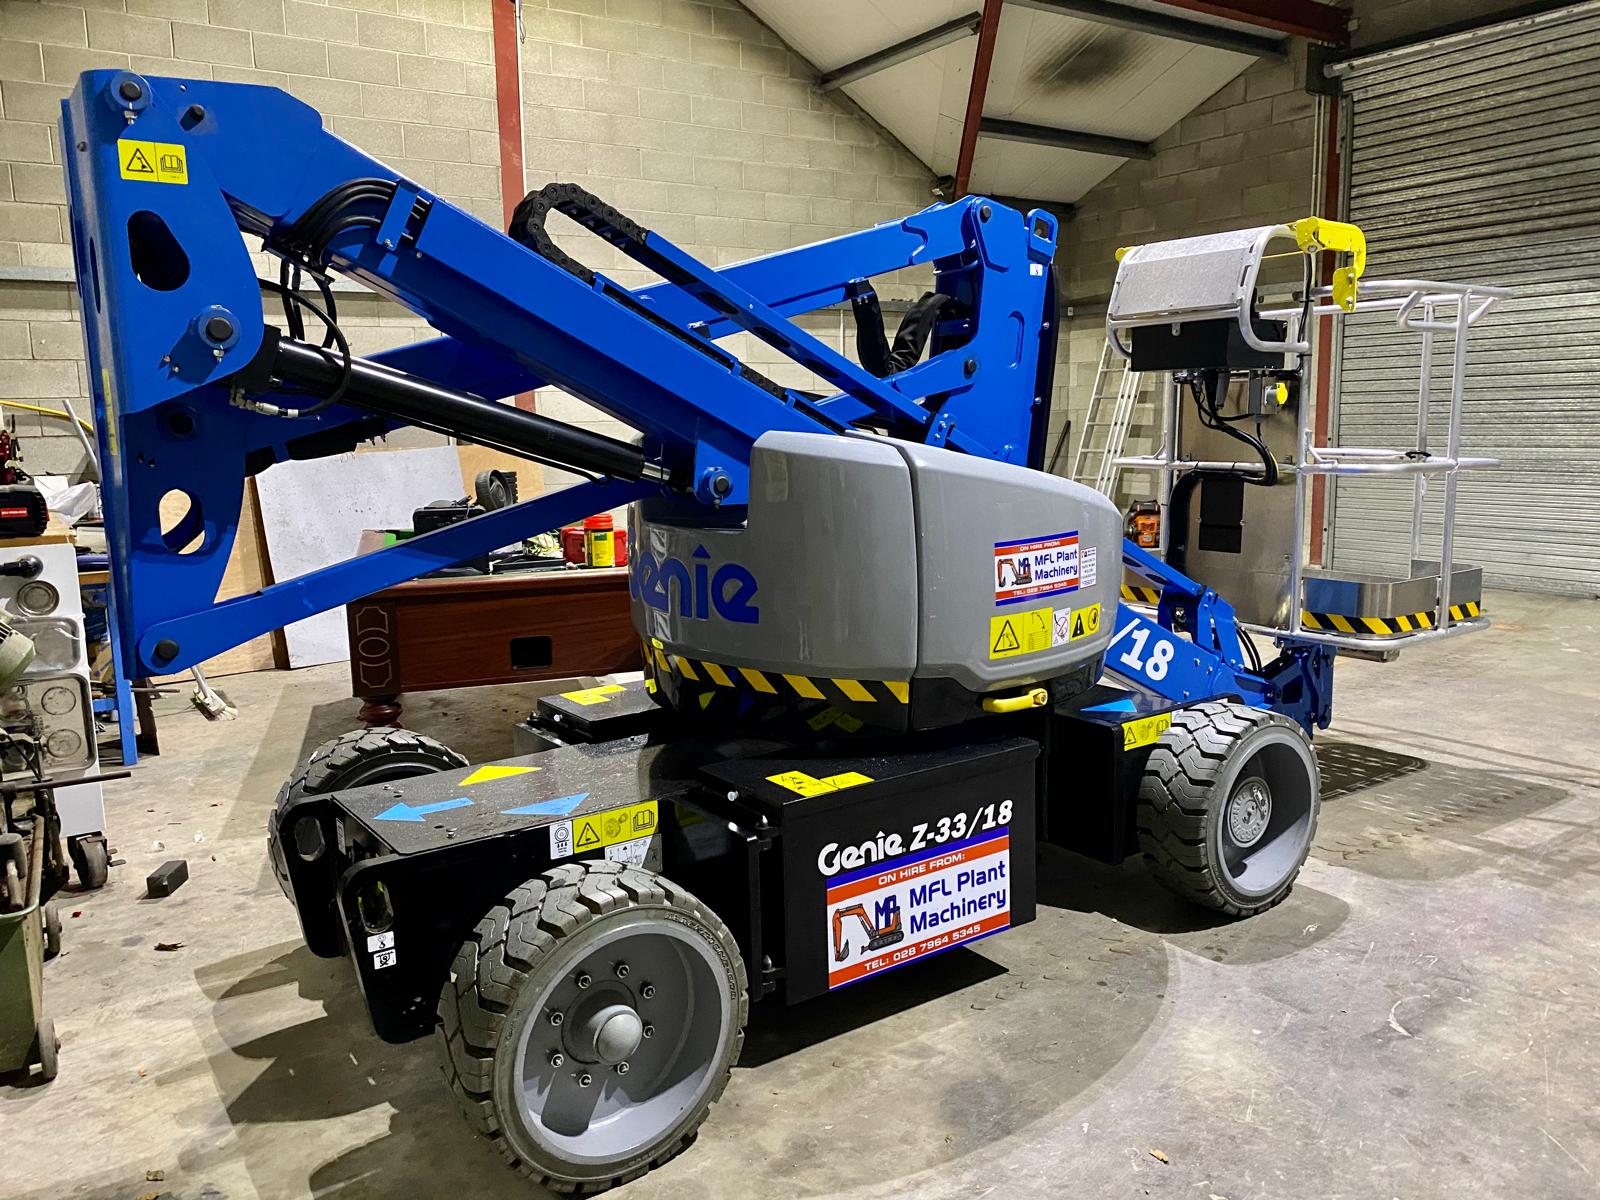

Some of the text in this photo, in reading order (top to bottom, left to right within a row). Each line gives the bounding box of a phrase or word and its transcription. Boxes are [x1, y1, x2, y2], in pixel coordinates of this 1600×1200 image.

[1034, 553, 1055, 566] MFL
[1056, 549, 1078, 563] Plant
[1034, 564, 1078, 581] Machinery
[909, 800, 1014, 851] Z-33/18
[878, 852, 966, 886] ON HIRE FROM:
[909, 860, 1006, 909] MFL Plant
[910, 888, 1007, 935] Machinery
[864, 924, 981, 971] TEL: 028 7964 5345
